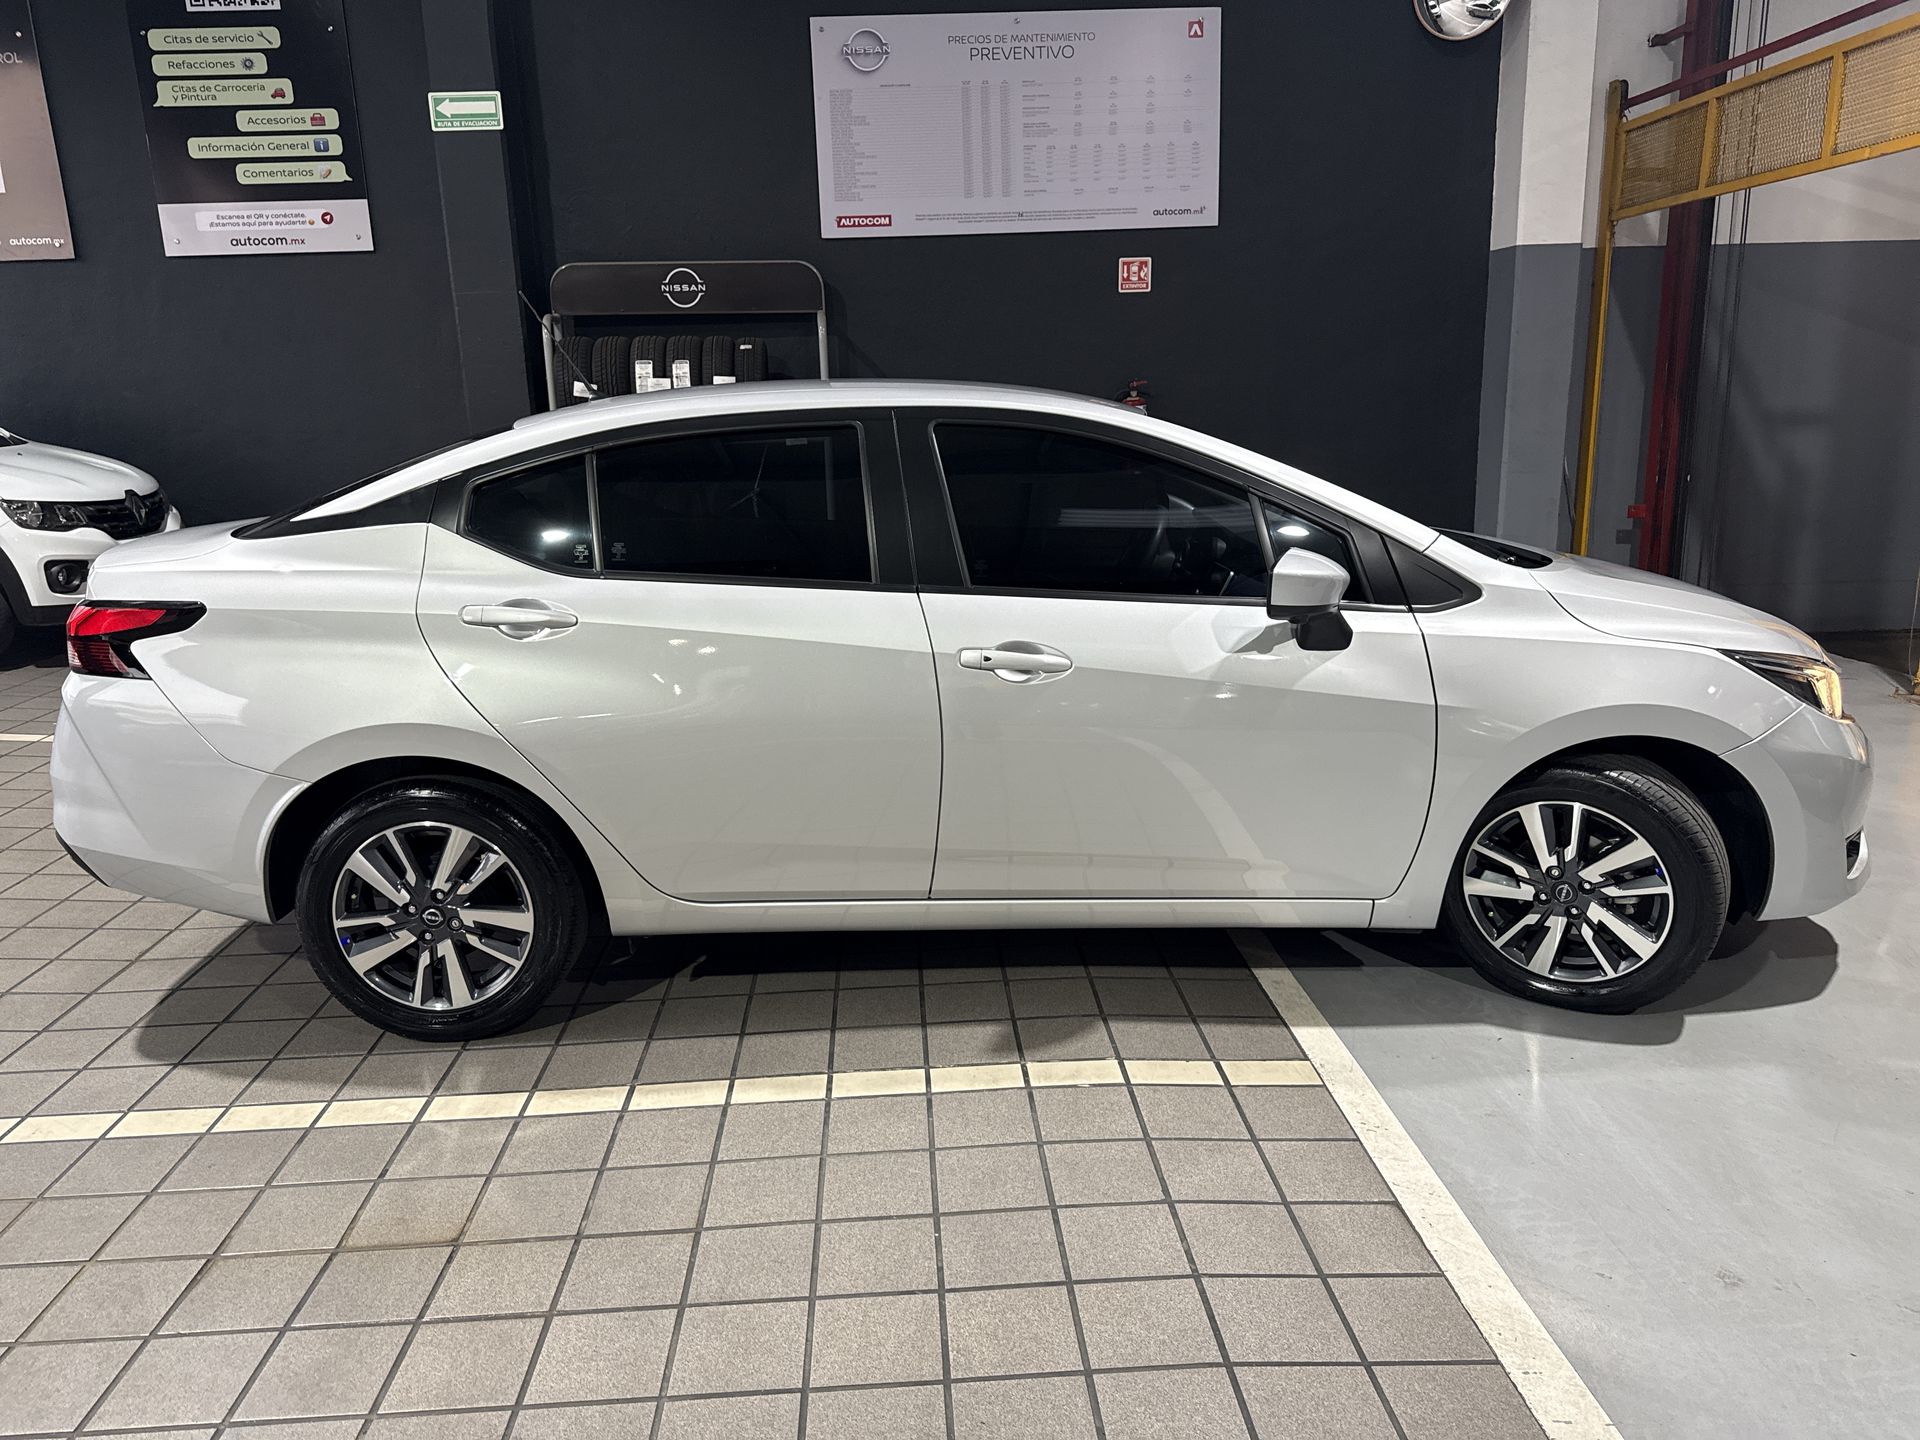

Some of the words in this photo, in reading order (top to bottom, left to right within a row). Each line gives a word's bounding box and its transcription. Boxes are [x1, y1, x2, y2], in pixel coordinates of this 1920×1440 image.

[163, 34, 193, 44] Citas
[195, 34, 209, 44] de
[211, 33, 255, 43] servicio
[948, 34, 991, 45] PRECIOS
[994, 34, 1008, 44] DE
[1010, 32, 1096, 43] MANTENIMIENTO
[842, 45, 891, 54] NISSAN
[969, 45, 1075, 61] PREVENTIVO
[168, 60, 236, 70] Refacciones
[171, 84, 197, 93] Citas
[199, 84, 211, 93] de
[214, 82, 266, 93] Carrocería
[172, 94, 179, 103] y
[181, 93, 217, 101] Pintura
[247, 115, 307, 125] Accesorios
[197, 141, 265, 152] Información
[267, 141, 310, 151] General
[242, 168, 314, 178] Comentarios
[839, 216, 890, 226] AUTOCOM
[230, 236, 306, 247] autocom.mx
[661, 284, 706, 292] NISSAN
